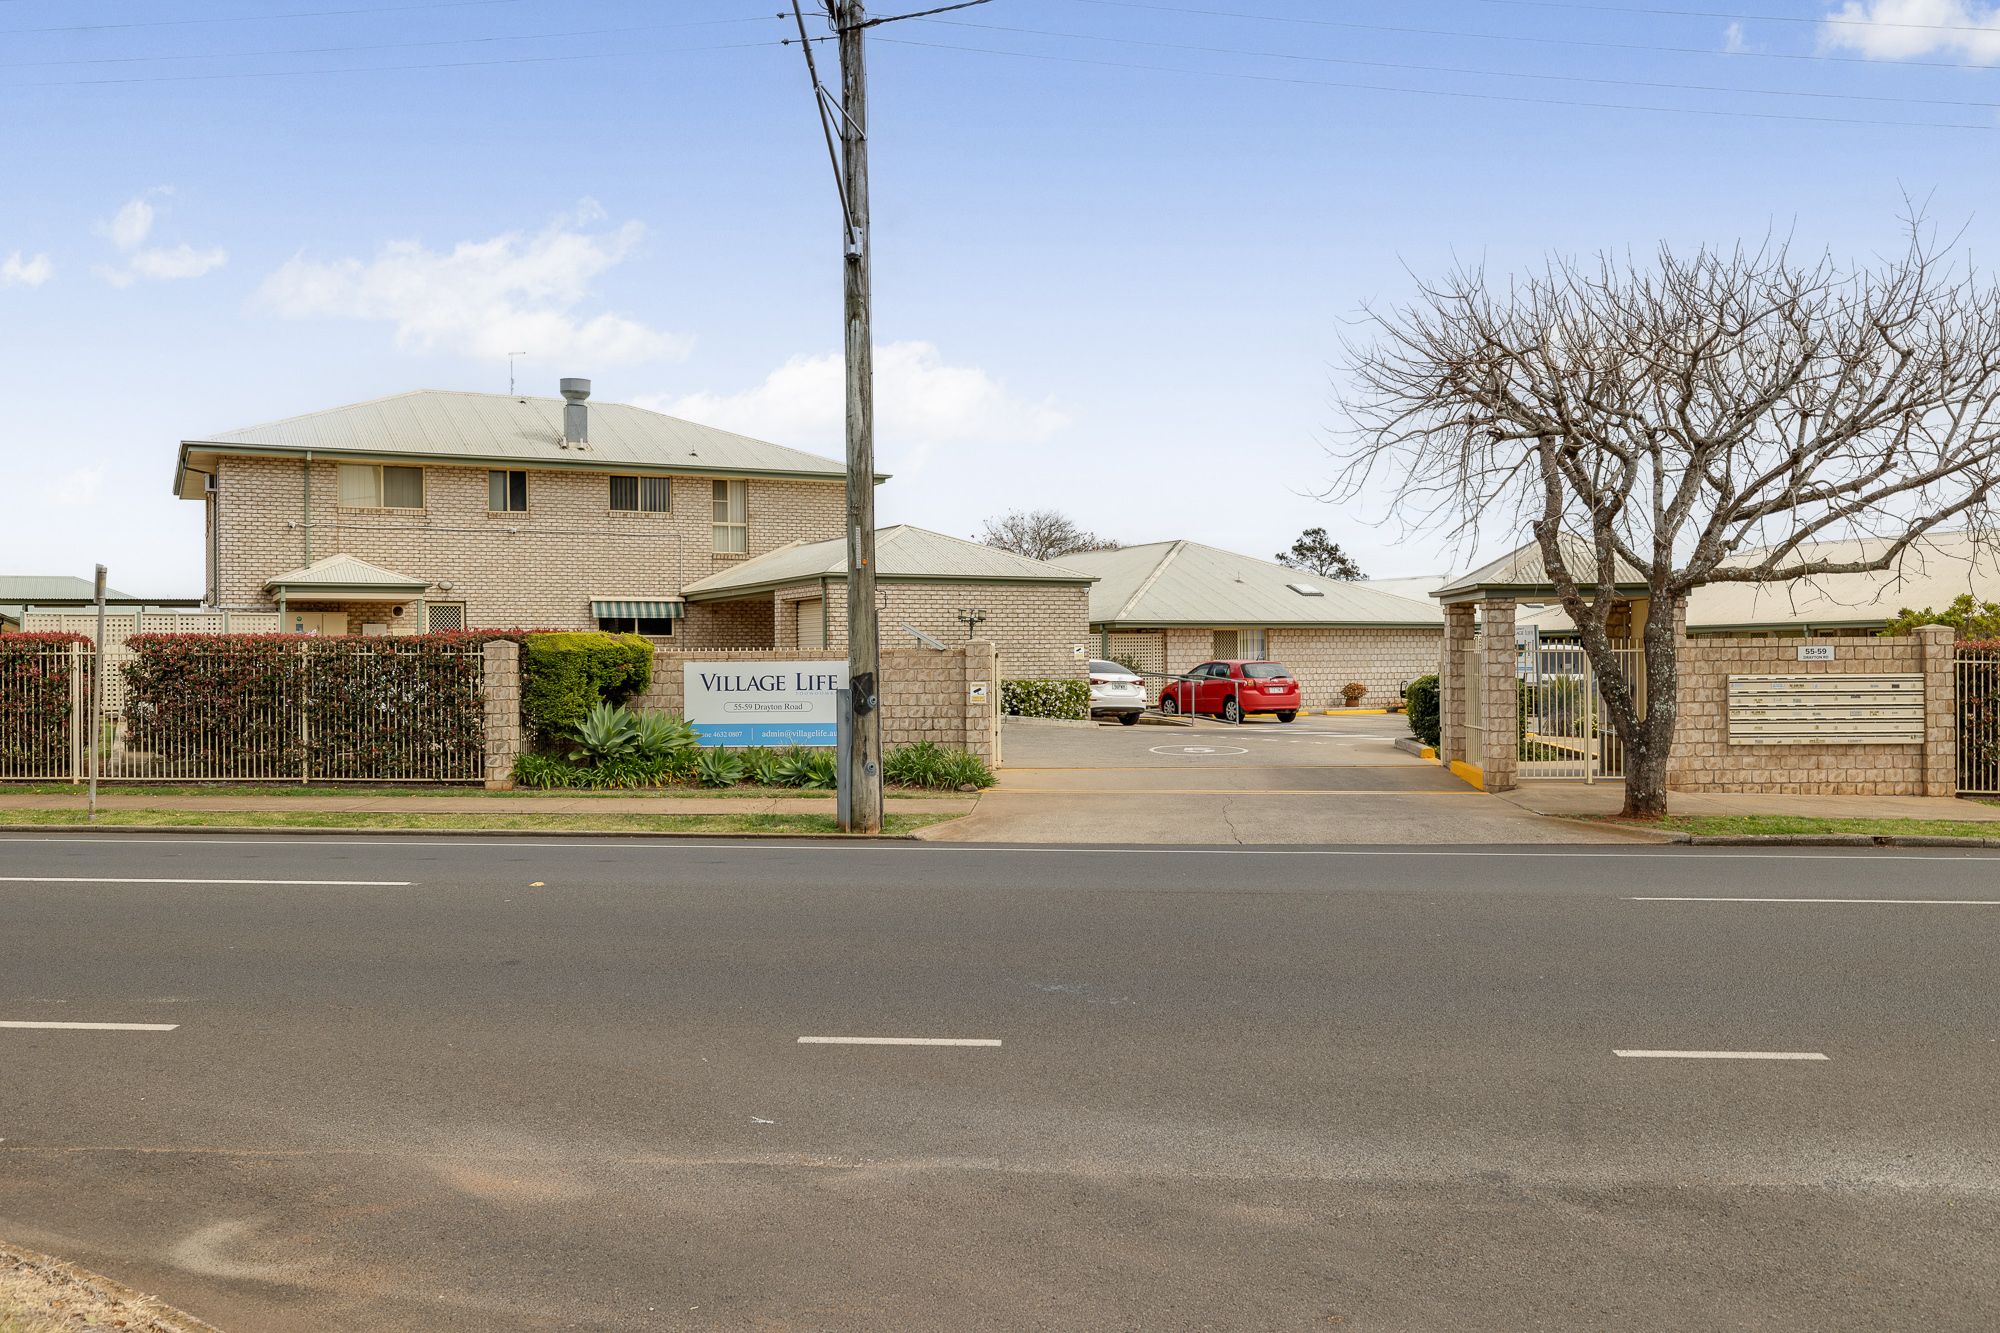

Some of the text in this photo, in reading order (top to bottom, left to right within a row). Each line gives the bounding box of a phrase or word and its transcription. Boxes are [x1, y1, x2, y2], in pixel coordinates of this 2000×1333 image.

[699, 672, 839, 692] VILLAGE LIFE
[733, 703, 803, 712] 55-59 Drayton Road
